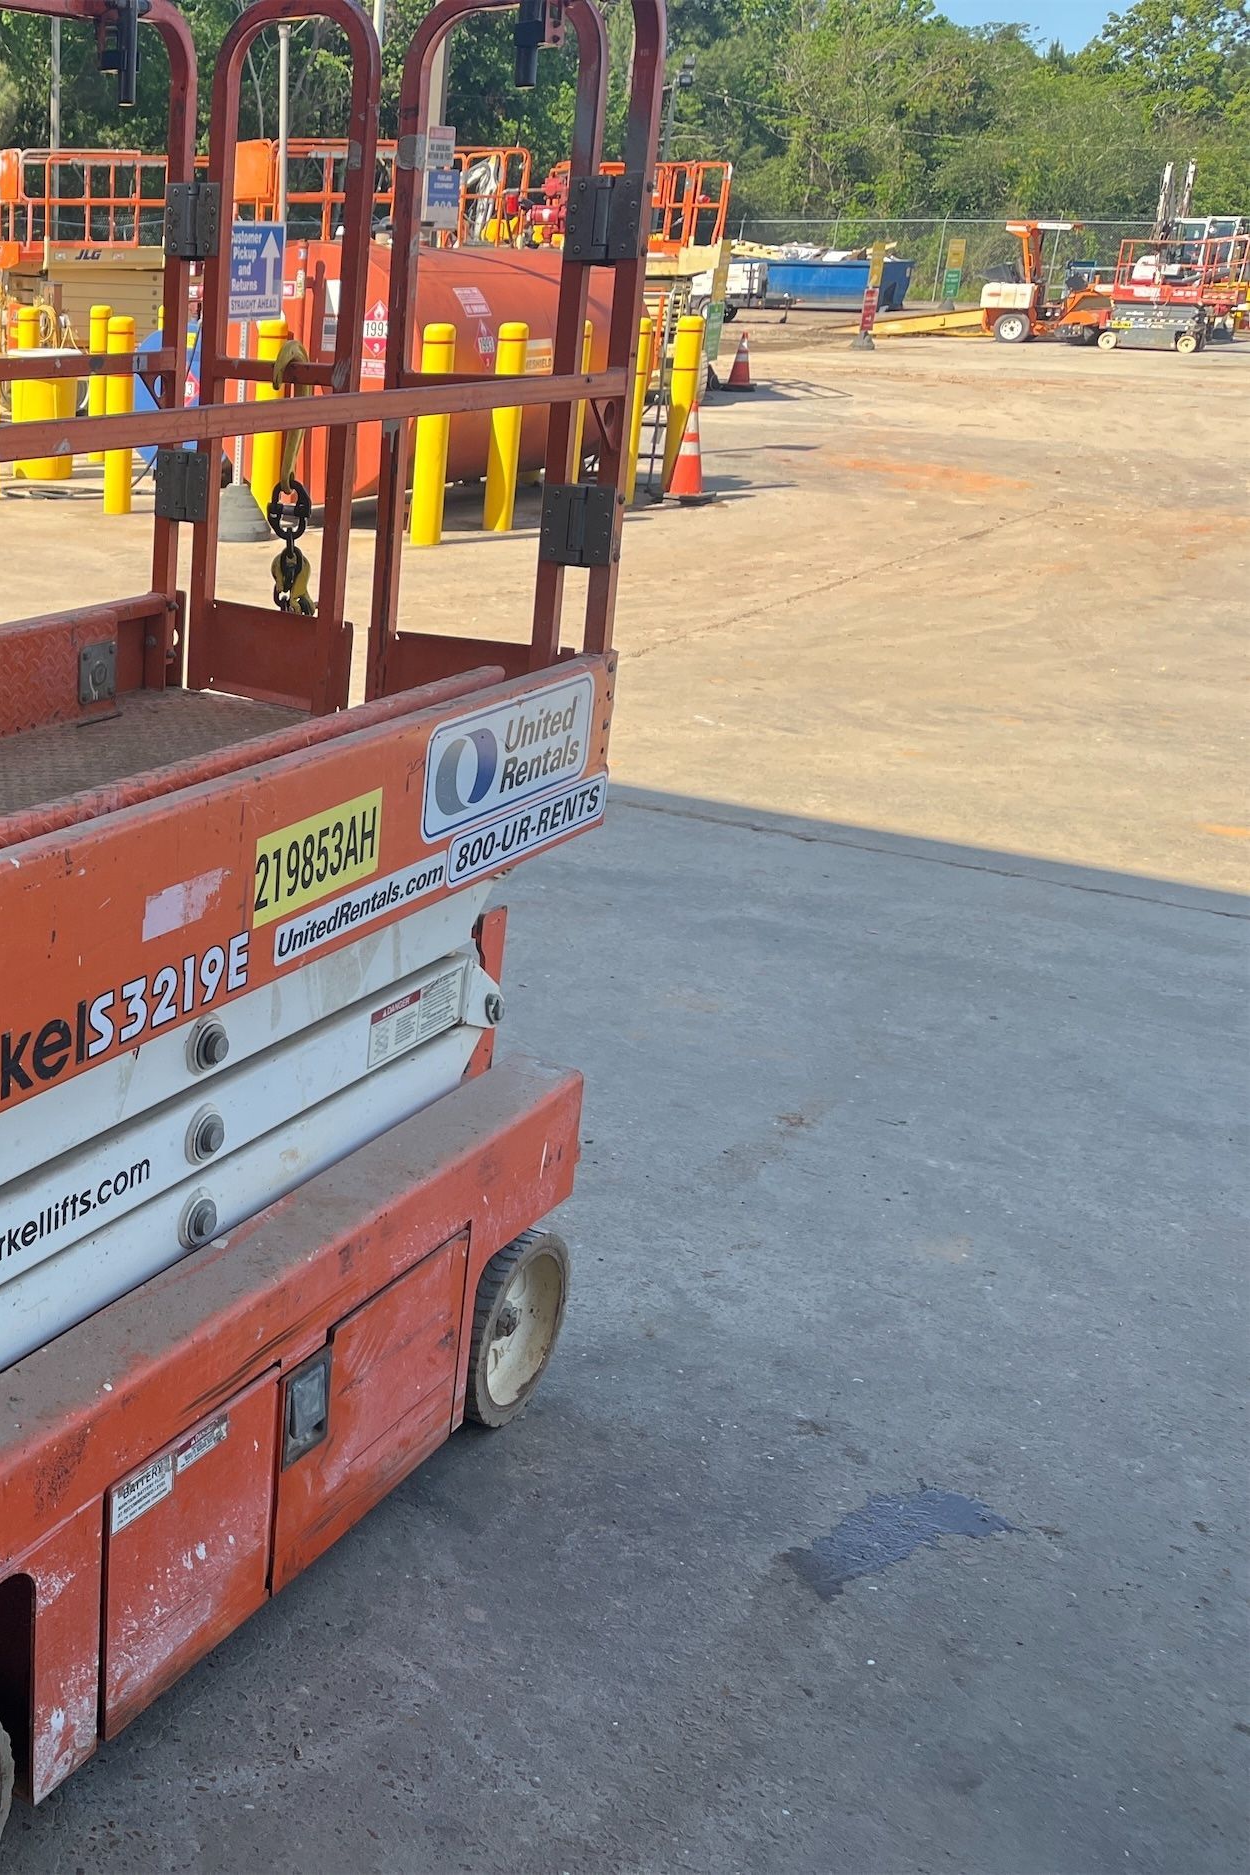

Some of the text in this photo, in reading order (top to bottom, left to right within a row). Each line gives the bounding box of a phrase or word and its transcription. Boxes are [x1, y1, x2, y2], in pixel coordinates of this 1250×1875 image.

[75, 249, 102, 260] JLG
[233, 246, 258, 263] Pickup
[238, 262, 251, 276] and
[231, 278, 258, 292] Returns
[231, 297, 278, 311] STRAIGHT AHEAD
[504, 697, 576, 753] United
[500, 735, 580, 794] Rentals
[455, 784, 600, 873] 800-UR-RENTS
[254, 806, 377, 912] 219853AH
[278, 865, 444, 957] UnitedRentals.com
[86, 931, 250, 1060] S3219E
[386, 996, 411, 1015] DANGER
[122, 1464, 163, 1499] BATTERY
